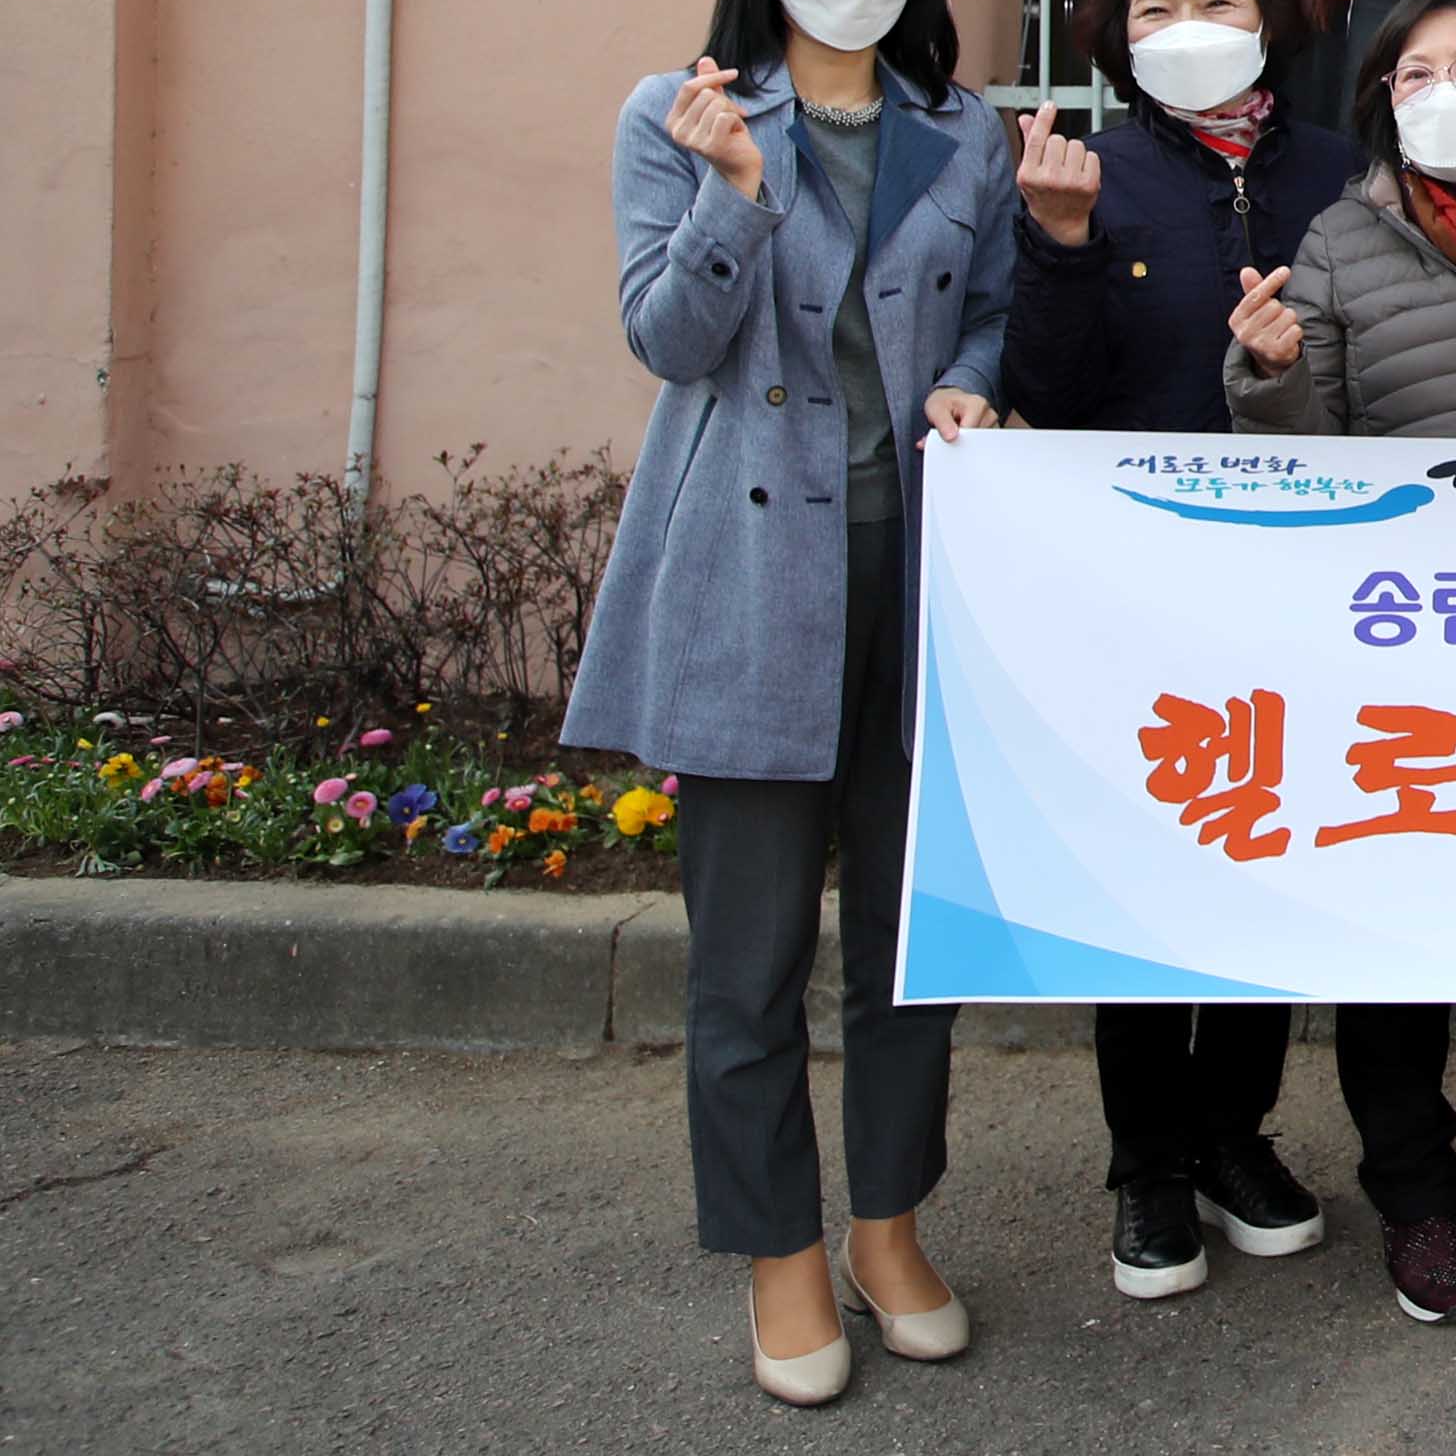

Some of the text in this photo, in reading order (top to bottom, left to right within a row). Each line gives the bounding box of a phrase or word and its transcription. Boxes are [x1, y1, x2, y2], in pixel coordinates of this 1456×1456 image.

[1115, 455, 1308, 476] 새로운 변화
[1173, 476, 1375, 501] 모두가 행복한
